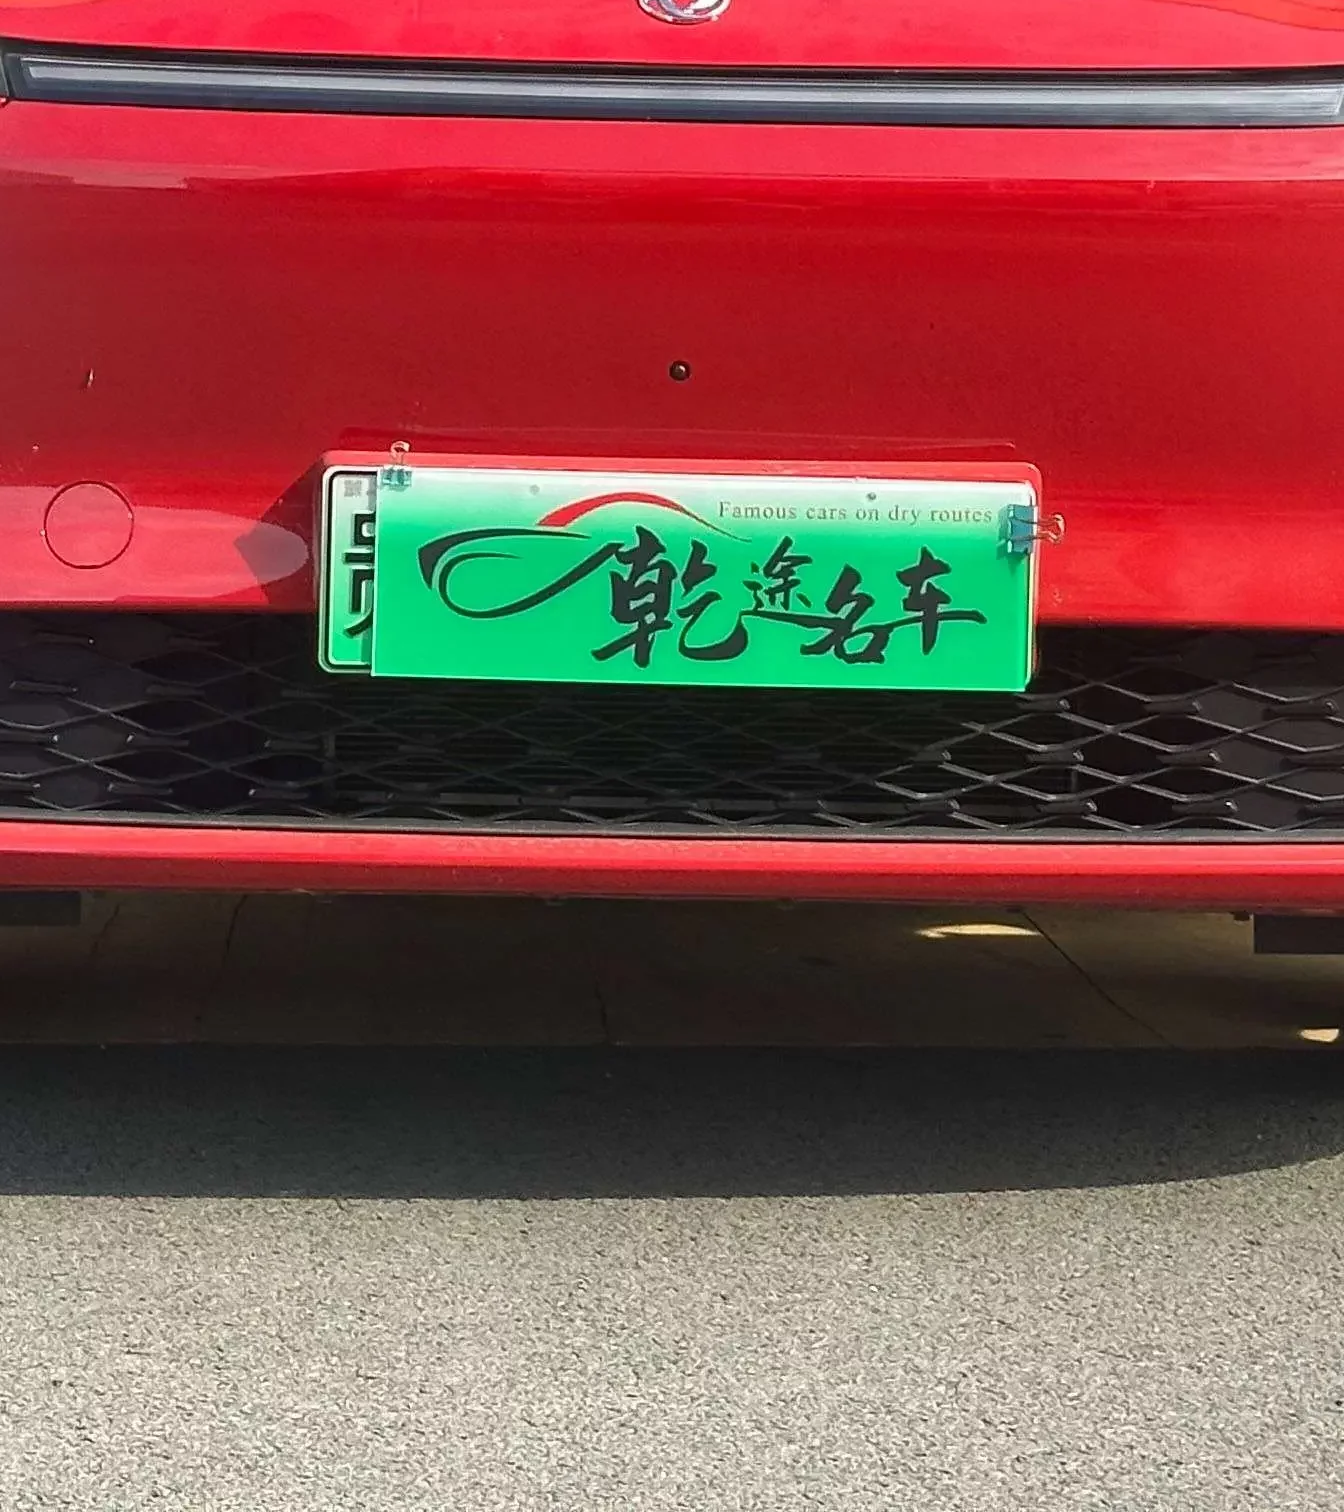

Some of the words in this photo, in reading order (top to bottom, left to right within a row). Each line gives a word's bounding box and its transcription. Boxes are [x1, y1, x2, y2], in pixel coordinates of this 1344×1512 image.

[718, 500, 798, 520] Famous
[806, 506, 847, 520] cars
[855, 508, 880, 522] on
[888, 505, 920, 526] dry
[930, 506, 993, 523] routes
[591, 524, 989, 668] 乾途名车
